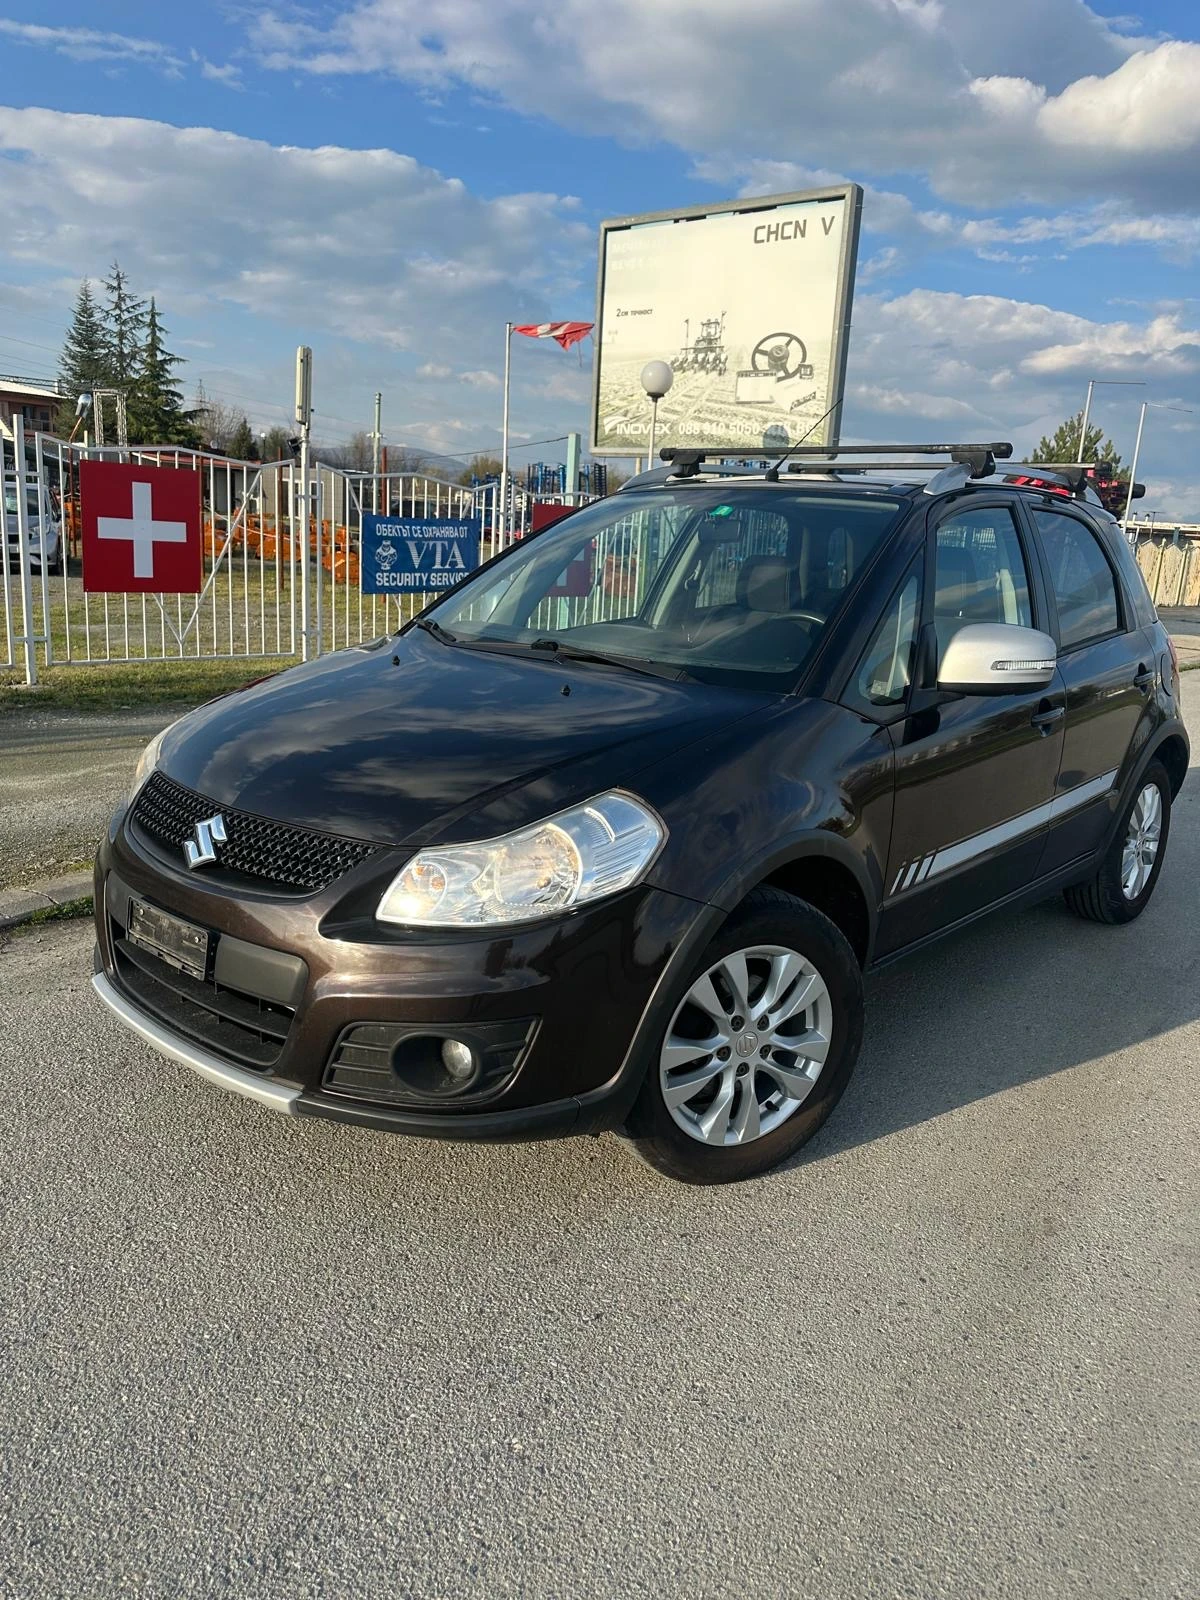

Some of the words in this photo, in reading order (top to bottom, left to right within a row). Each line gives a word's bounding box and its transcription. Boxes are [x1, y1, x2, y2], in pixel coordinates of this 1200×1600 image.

[616, 423, 671, 435] INOVEX
[375, 523, 411, 537] ОБЕКТЪТ
[411, 525, 423, 538] СЕ
[422, 526, 459, 538] ОХРАНЯВА
[459, 526, 468, 539] ОТ
[405, 540, 466, 570] VTA
[375, 572, 428, 587] SECURITY
[430, 572, 469, 586] SERVIC
